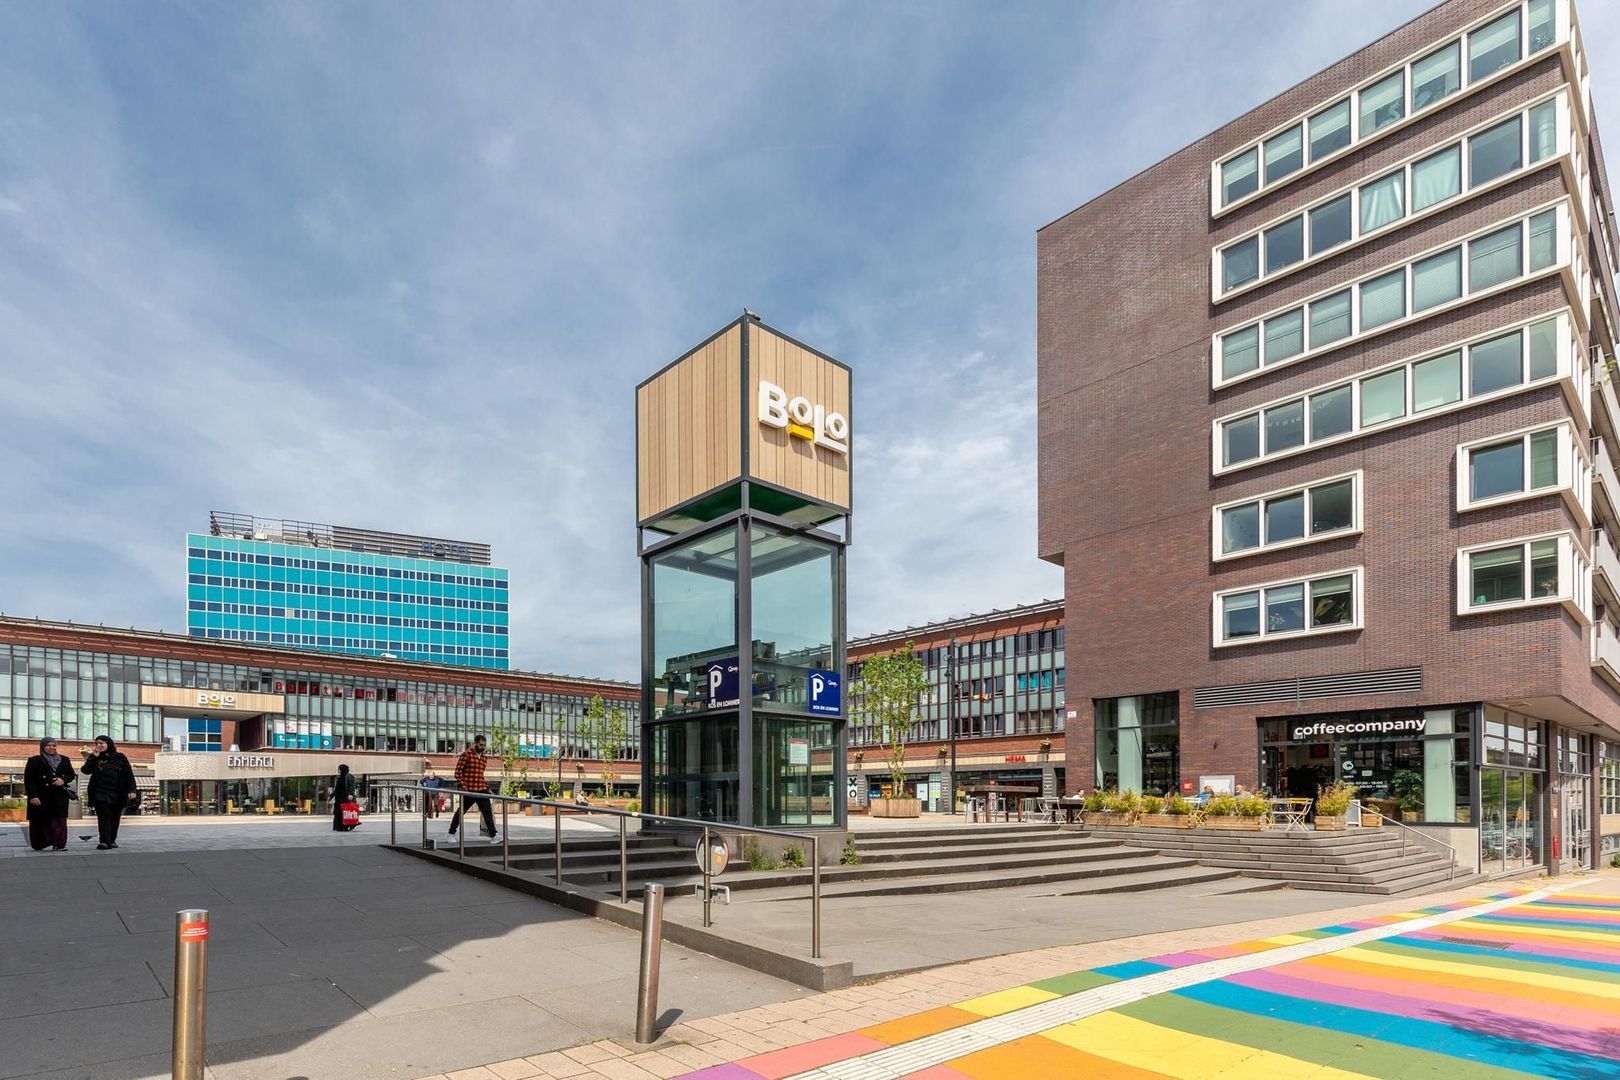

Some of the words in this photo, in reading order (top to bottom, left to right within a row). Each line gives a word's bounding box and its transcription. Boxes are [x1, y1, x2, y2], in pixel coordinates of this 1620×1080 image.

[710, 671, 722, 697] P
[812, 678, 824, 700] P
[1294, 719, 1426, 736] coffeecompany
